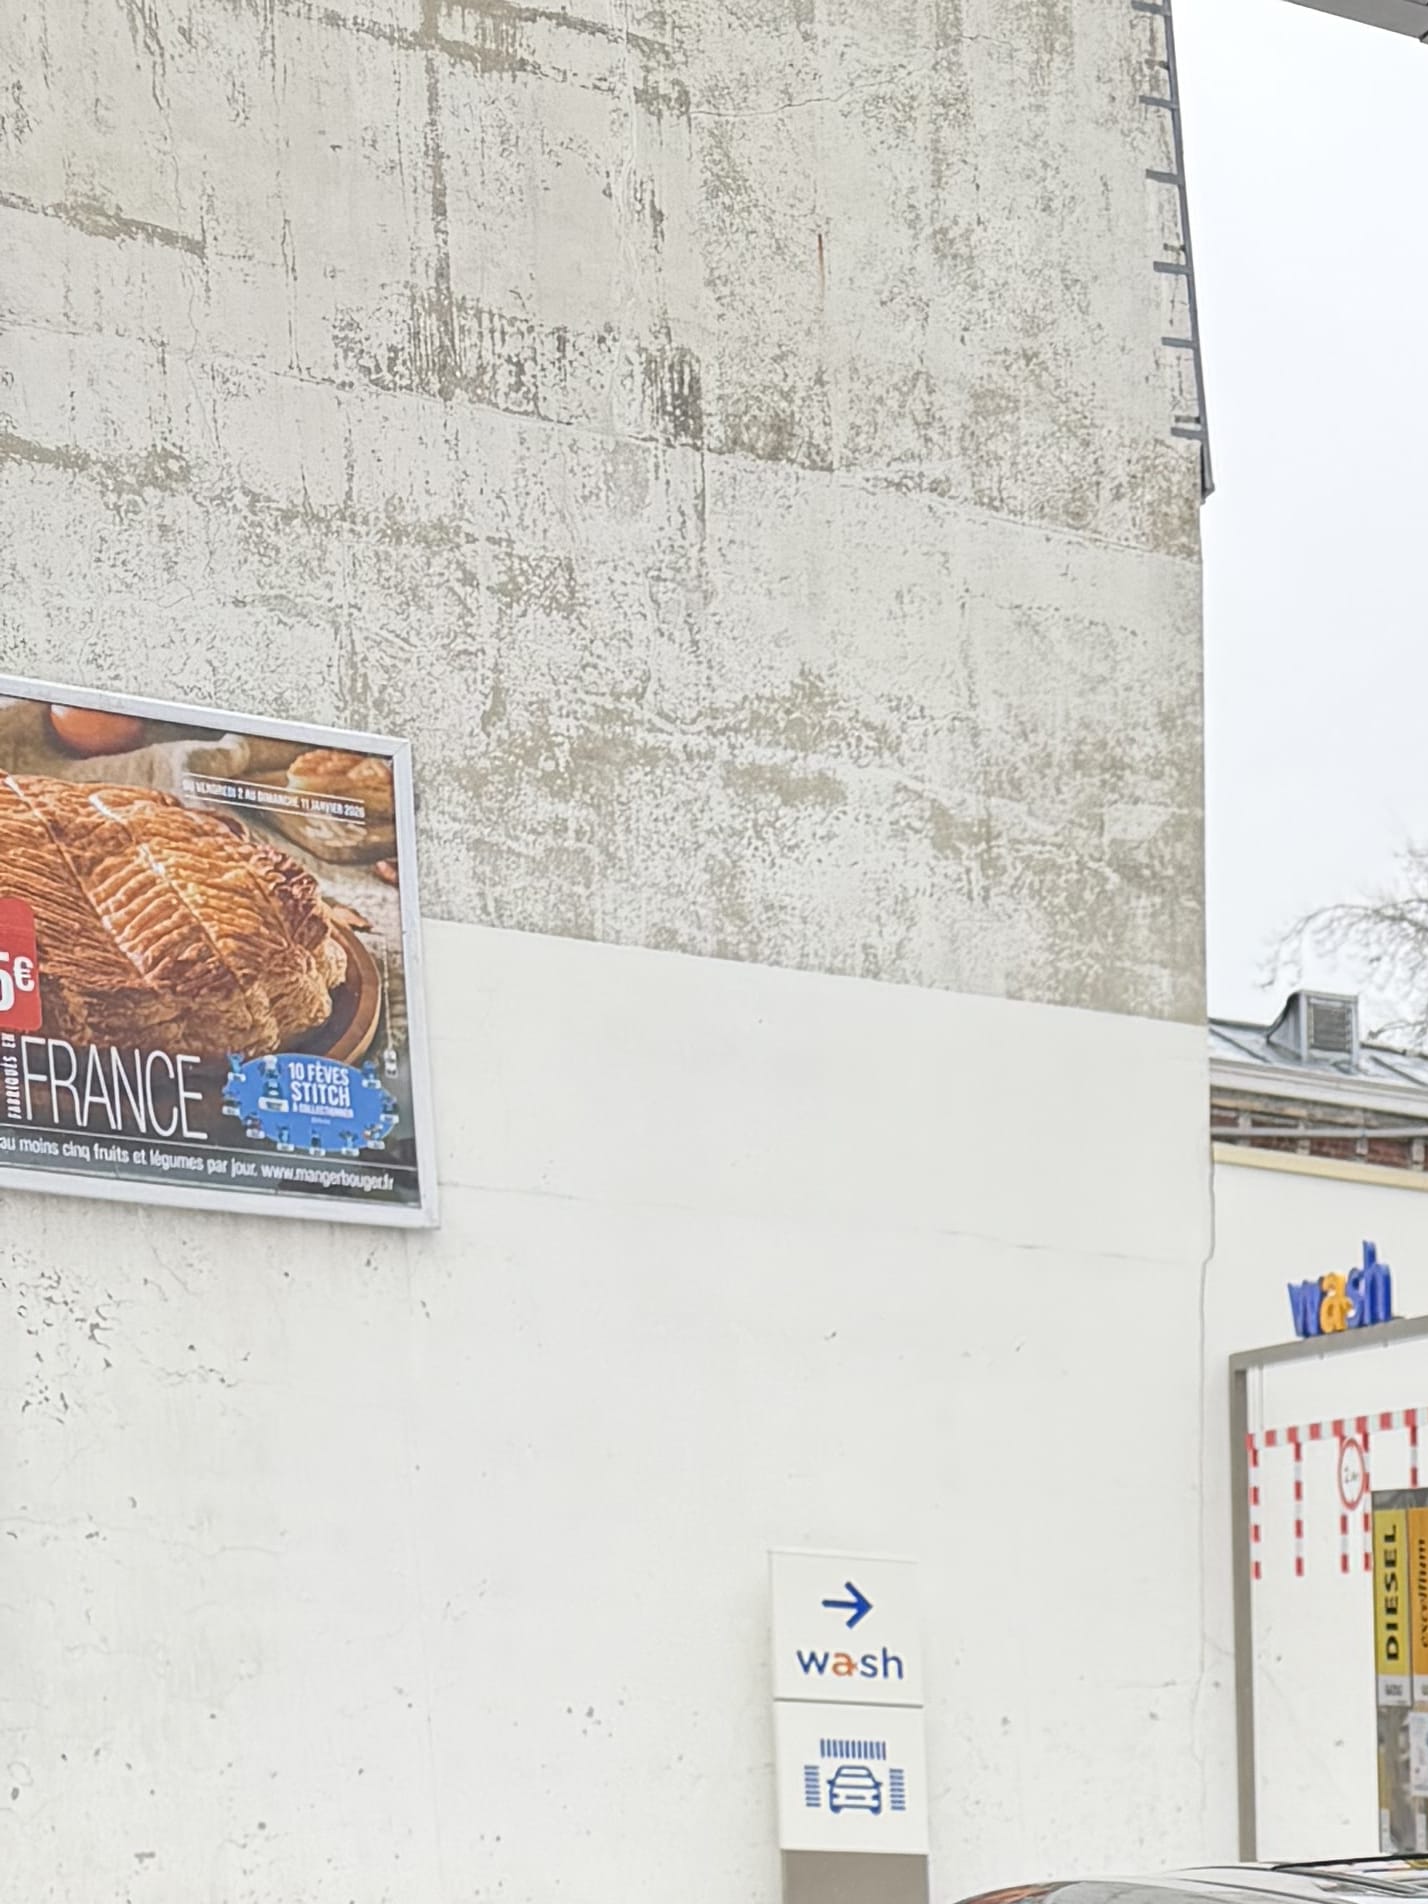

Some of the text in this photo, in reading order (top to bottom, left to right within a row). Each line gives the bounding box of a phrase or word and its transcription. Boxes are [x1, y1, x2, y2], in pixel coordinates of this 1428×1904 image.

[20, 1034, 209, 1140] FRANCE
[287, 1060, 350, 1084] 10 FÈVES
[290, 1081, 351, 1107] STITCH
[19, 1136, 60, 1155] moins
[62, 1139, 90, 1162] cinq
[93, 1145, 130, 1164] fruits
[133, 1149, 148, 1165] et
[149, 1150, 204, 1172] légumes
[206, 1158, 227, 1175] par
[231, 1158, 258, 1178] jour.
[260, 1163, 395, 1192] www.mangerbouger.fr
[1286, 1238, 1393, 1340] wash
[1383, 1523, 1400, 1663] DIESEL
[795, 1646, 905, 1681] wash
